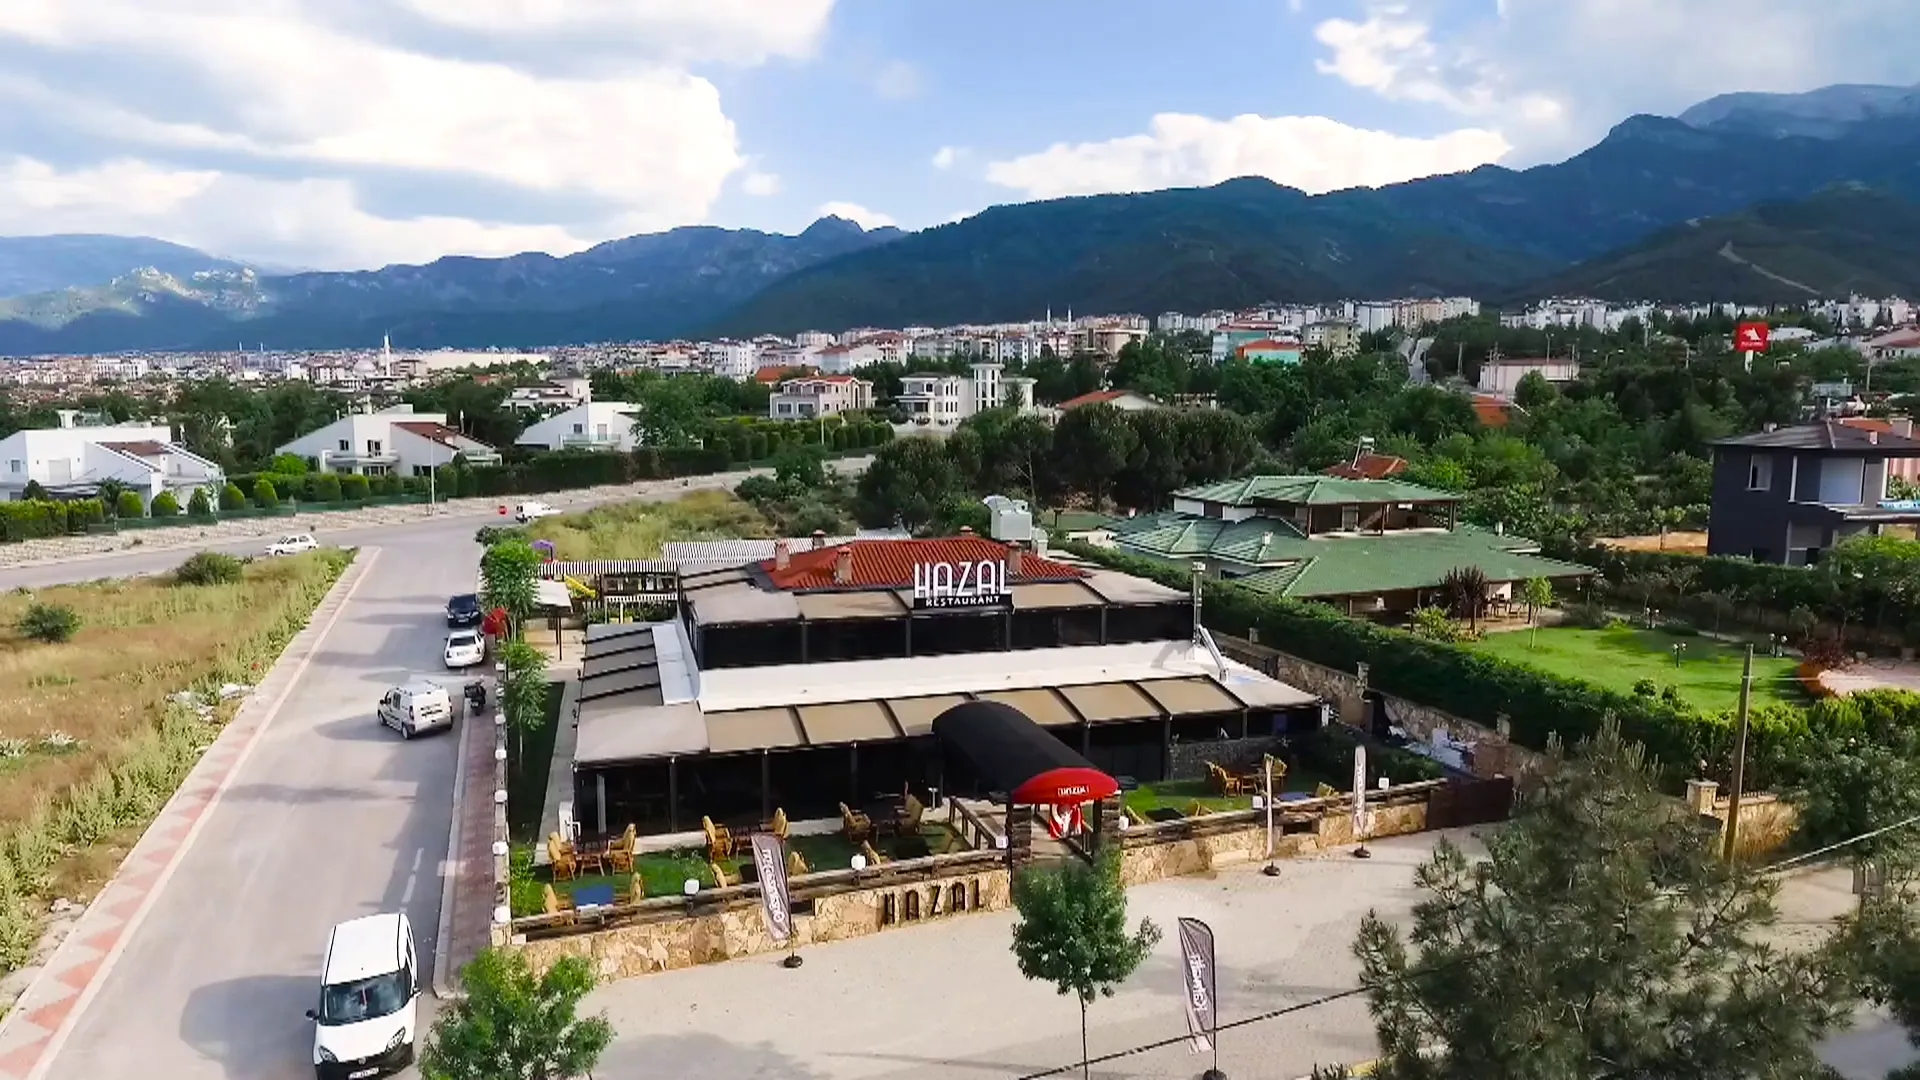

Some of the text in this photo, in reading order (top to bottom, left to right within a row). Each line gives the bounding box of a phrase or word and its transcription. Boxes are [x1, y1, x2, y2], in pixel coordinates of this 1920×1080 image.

[914, 559, 1012, 598] HAZAL
[925, 595, 1000, 607] RESTAURANT
[884, 878, 984, 925] HAZAL
